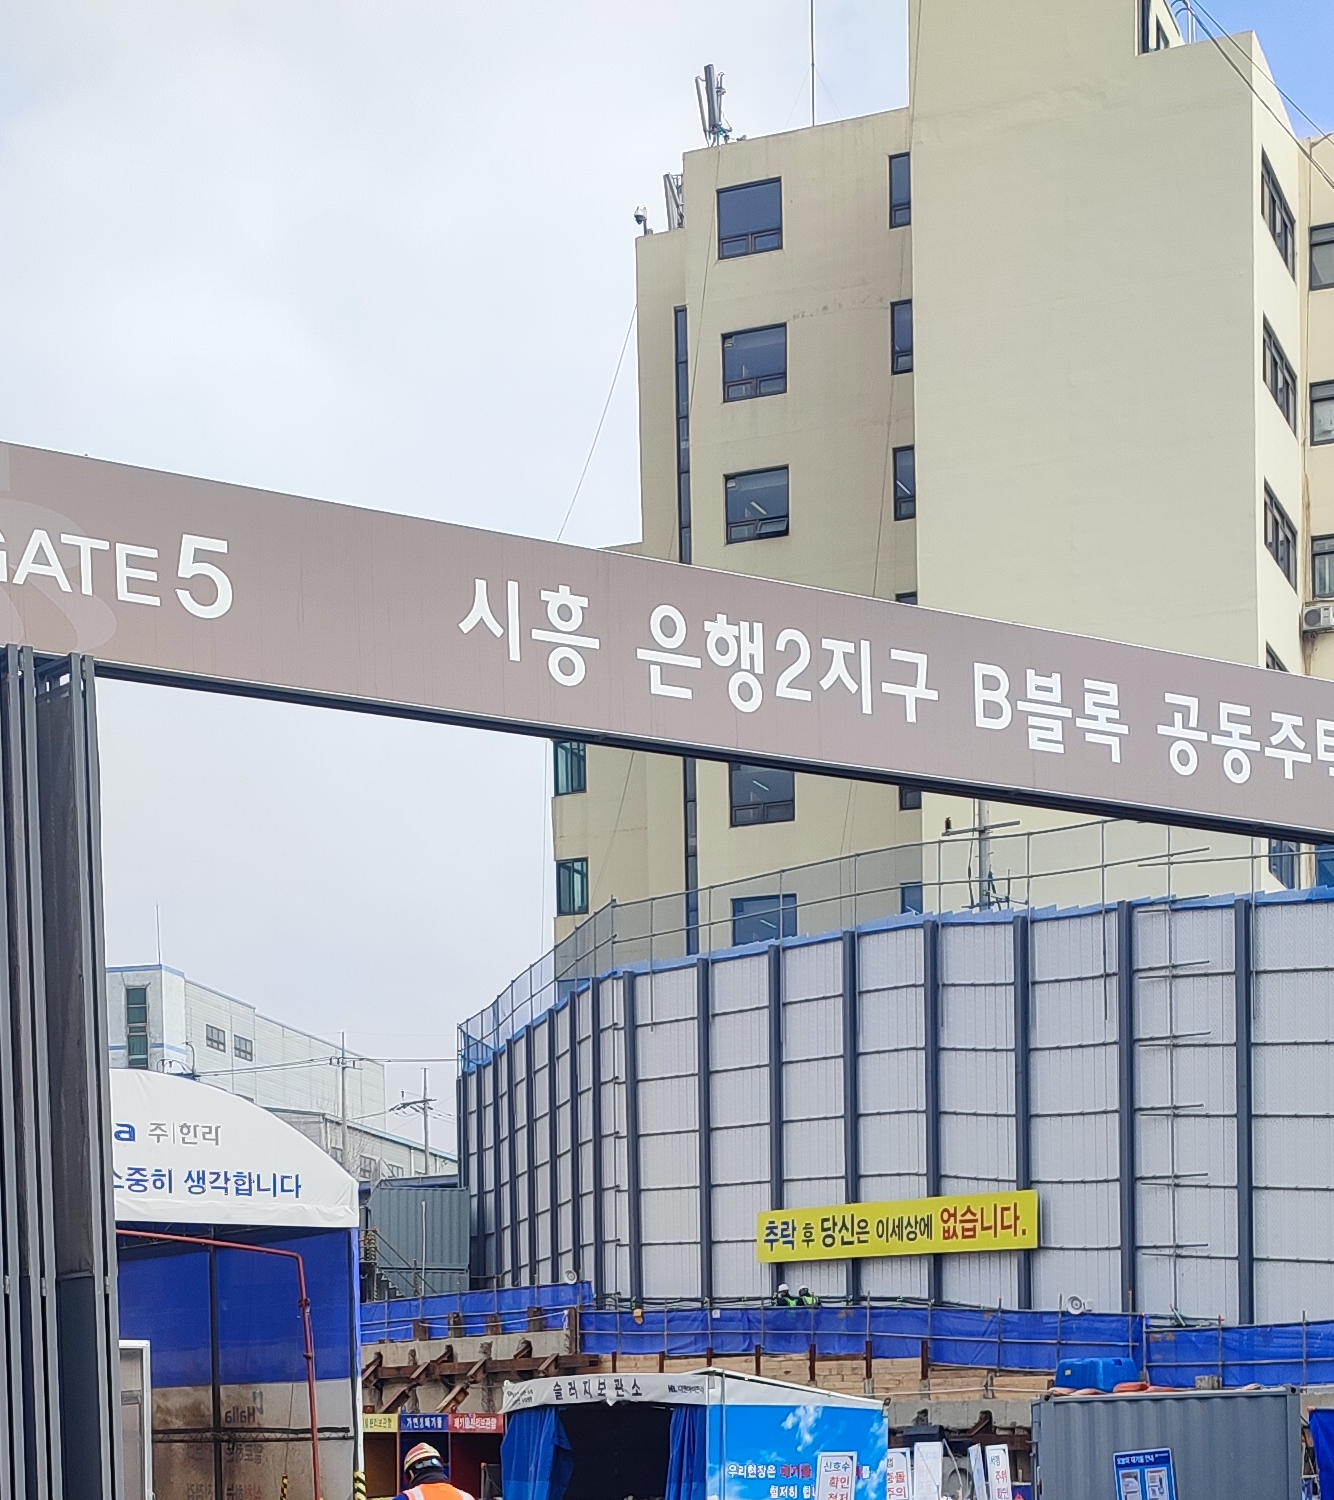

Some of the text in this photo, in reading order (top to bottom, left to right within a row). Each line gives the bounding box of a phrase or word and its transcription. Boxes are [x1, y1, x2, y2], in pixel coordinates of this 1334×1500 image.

[175, 533, 233, 619] 5
[458, 578, 600, 688] 시흥
[635, 603, 939, 725] 은행2지구
[973, 662, 1130, 764] B블록
[184, 1169, 302, 1198] 생각합니다
[764, 1202, 1027, 1252] 추락 후 당신은 이세상에 없습니다.
[727, 1464, 777, 1480] 우리현장은
[823, 1461, 851, 1472] 신호수
[828, 1476, 850, 1490] 확인
